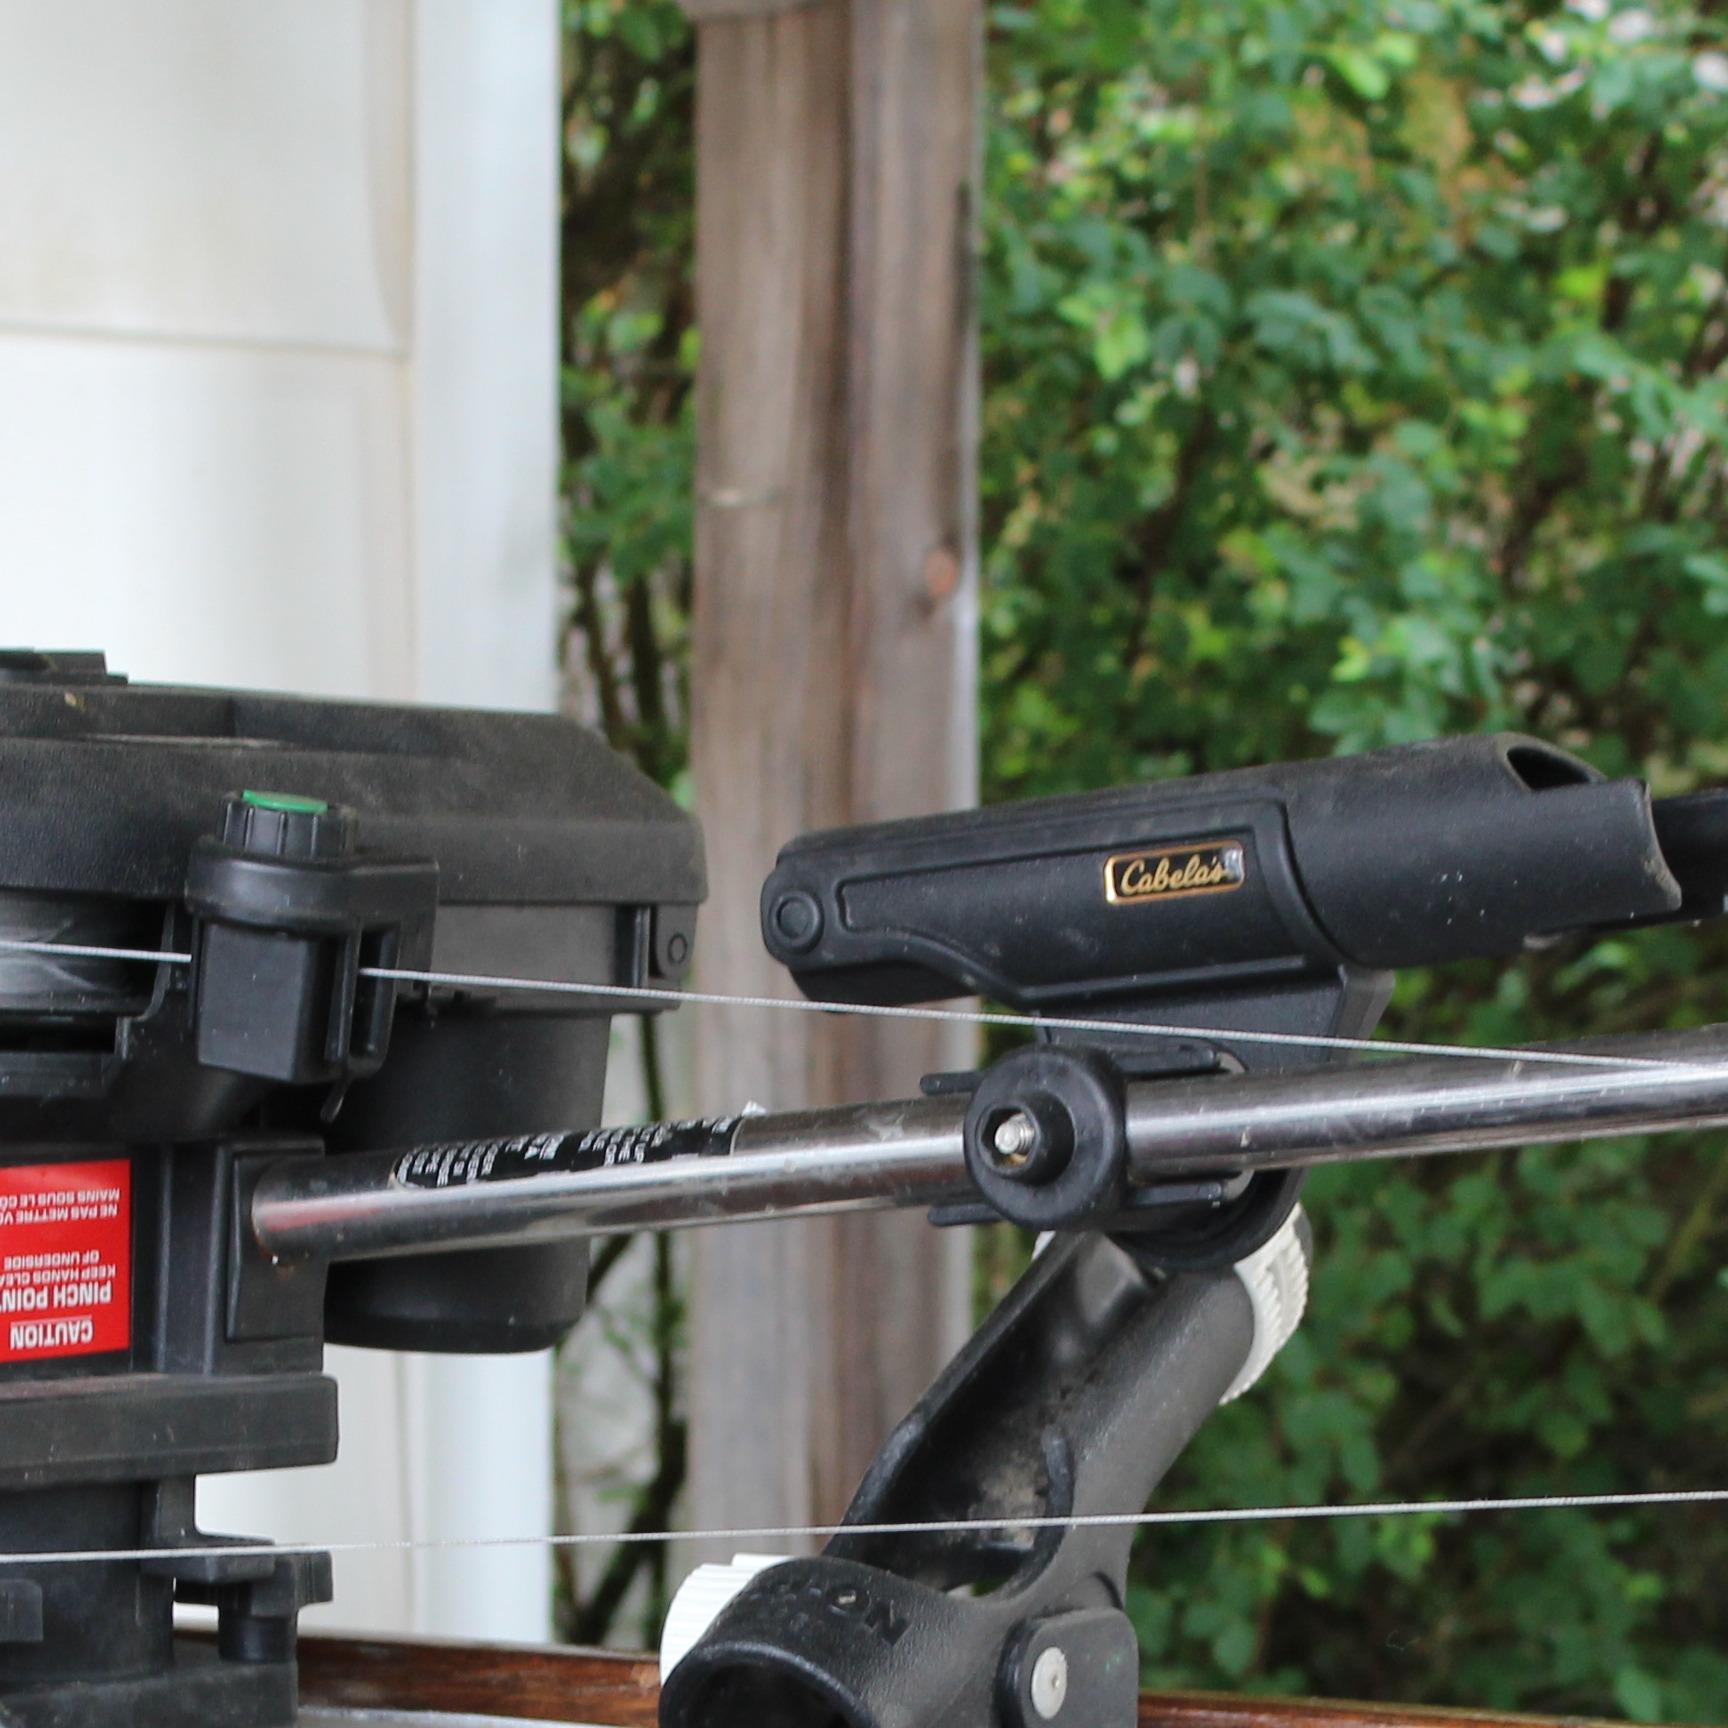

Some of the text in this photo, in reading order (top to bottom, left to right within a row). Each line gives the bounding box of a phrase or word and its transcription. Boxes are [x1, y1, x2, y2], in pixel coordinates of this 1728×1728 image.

[1120, 854, 1229, 896] Cabela's
[20, 1193, 36, 1206] LE
[38, 1190, 74, 1204] SOUS
[78, 1188, 120, 1203] MAINS
[16, 1207, 68, 1225] METTRE
[72, 1206, 98, 1220] PAS
[101, 1204, 118, 1217] NE
[4, 1250, 100, 1270] OF UNDERSIDE
[33, 1268, 79, 1285] HANDS
[81, 1264, 116, 1279] KEEP
[53, 1280, 112, 1308] PINCH
[10, 1318, 93, 1350] CAUTION
